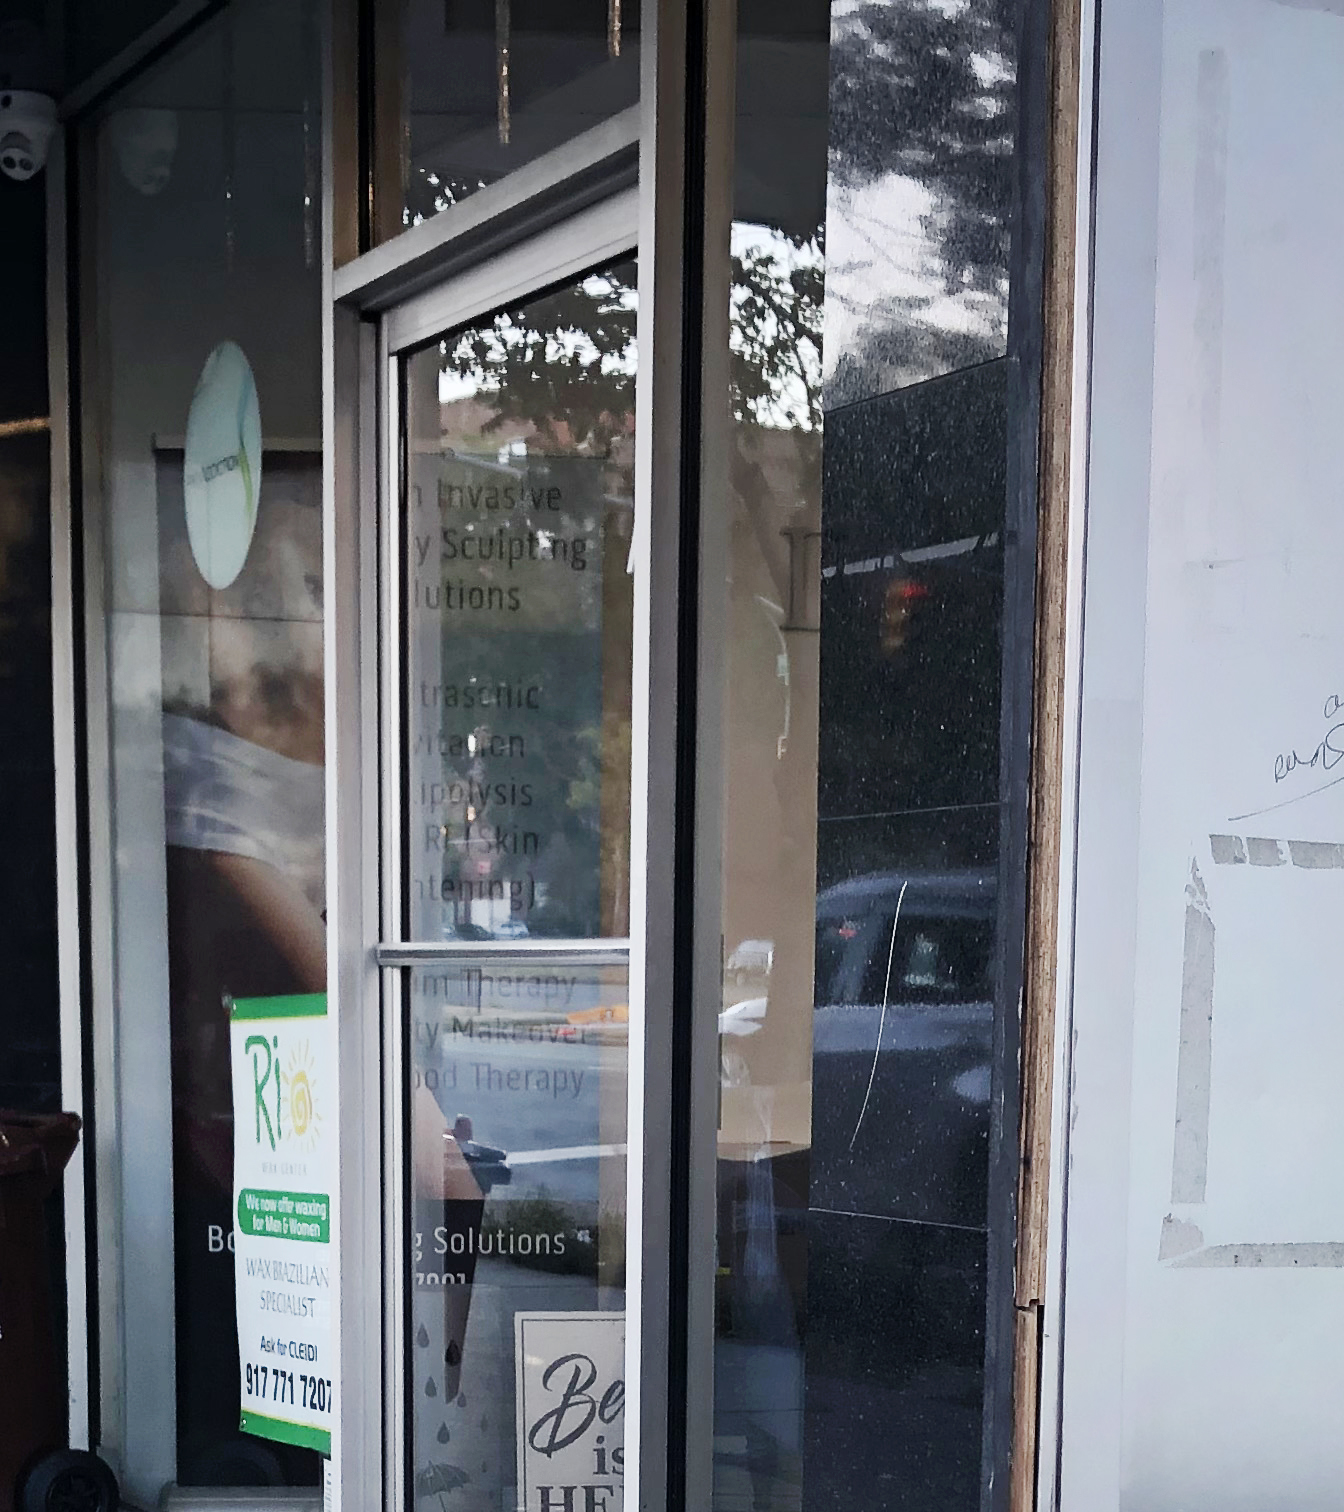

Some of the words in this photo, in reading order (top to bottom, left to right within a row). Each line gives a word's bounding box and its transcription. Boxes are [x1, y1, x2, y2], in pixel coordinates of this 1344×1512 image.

[470, 1061, 585, 1099] Therapy
[295, 1200, 327, 1220] waxing
[289, 1218, 321, 1238] Women
[433, 1225, 566, 1256] Solutions
[272, 1260, 330, 1289] BRAZILIAN
[259, 1290, 317, 1319] SPECIALIST
[259, 1335, 276, 1353] Ask
[276, 1338, 288, 1356] for
[245, 1362, 268, 1399] 917
[272, 1368, 295, 1405] 771
[299, 1374, 333, 1414] 7207
